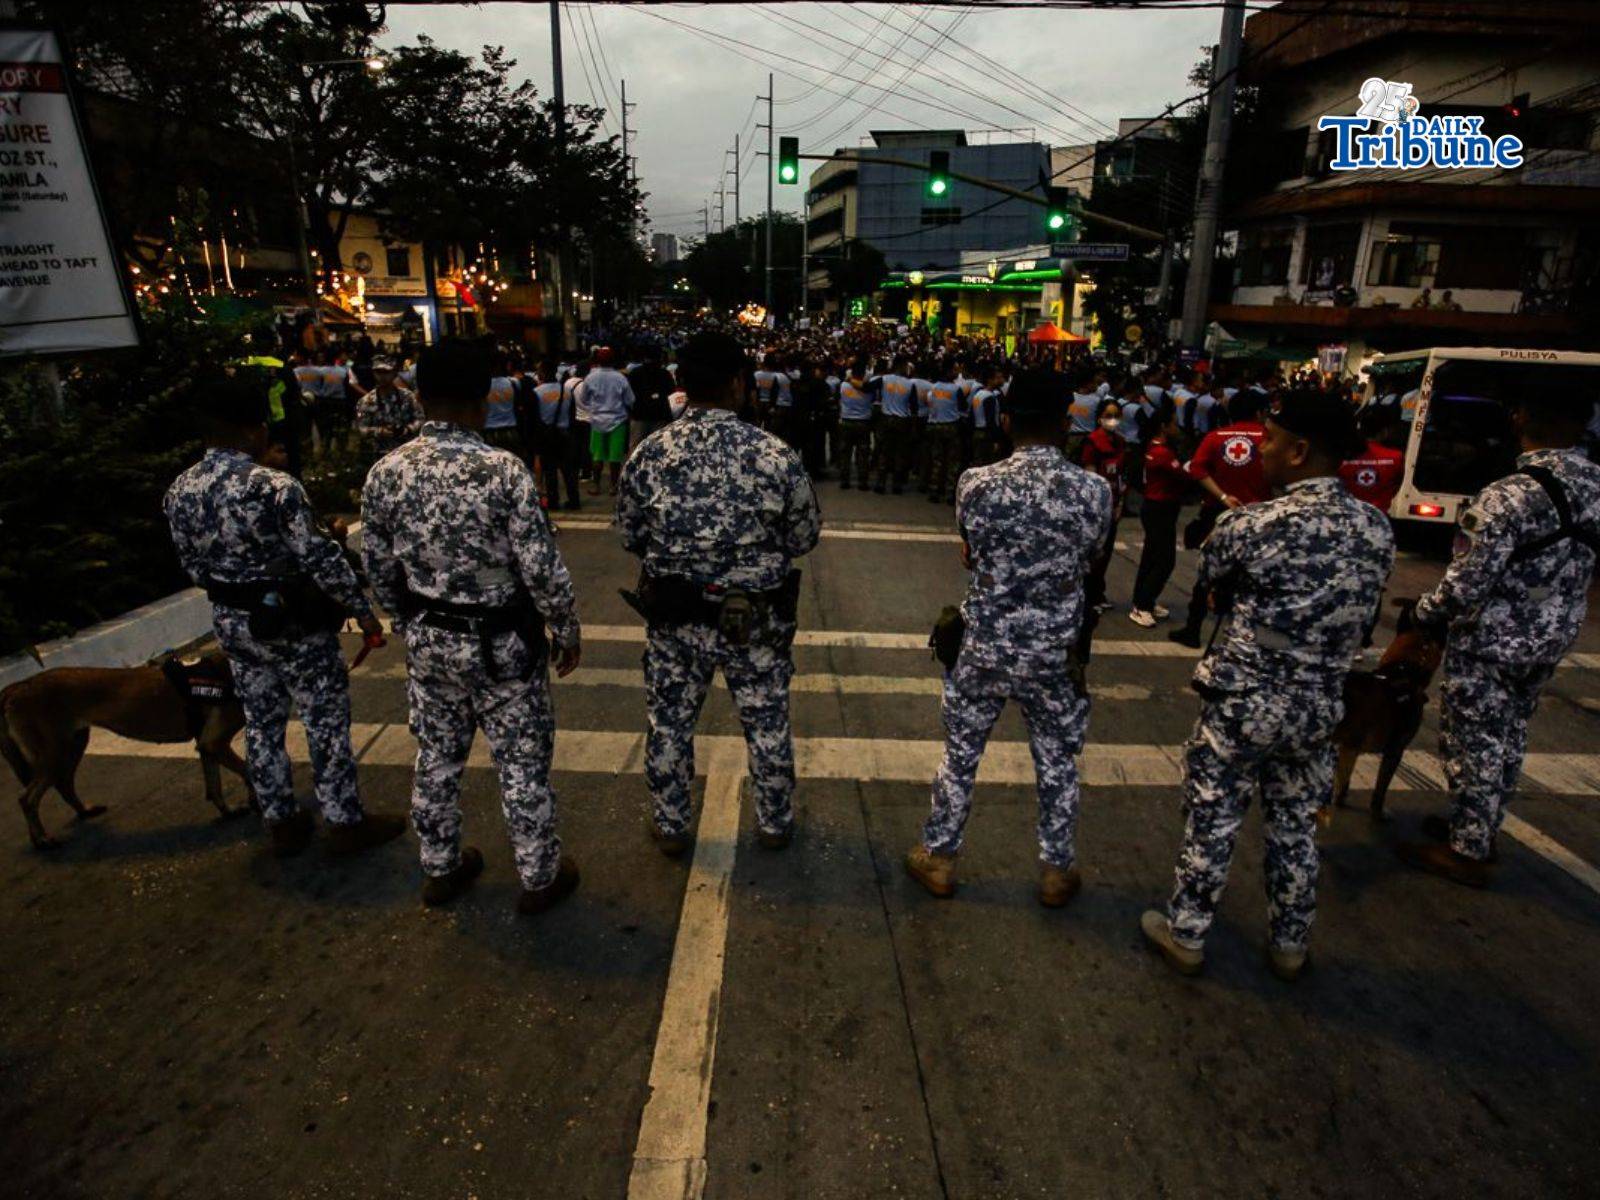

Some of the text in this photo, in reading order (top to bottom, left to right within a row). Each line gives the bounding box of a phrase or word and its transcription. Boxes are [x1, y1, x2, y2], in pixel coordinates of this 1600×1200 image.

[0, 68, 42, 87] ORY
[43, 258, 61, 269] TO
[64, 257, 97, 269] TAFT
[1499, 350, 1558, 361] PULISYA
